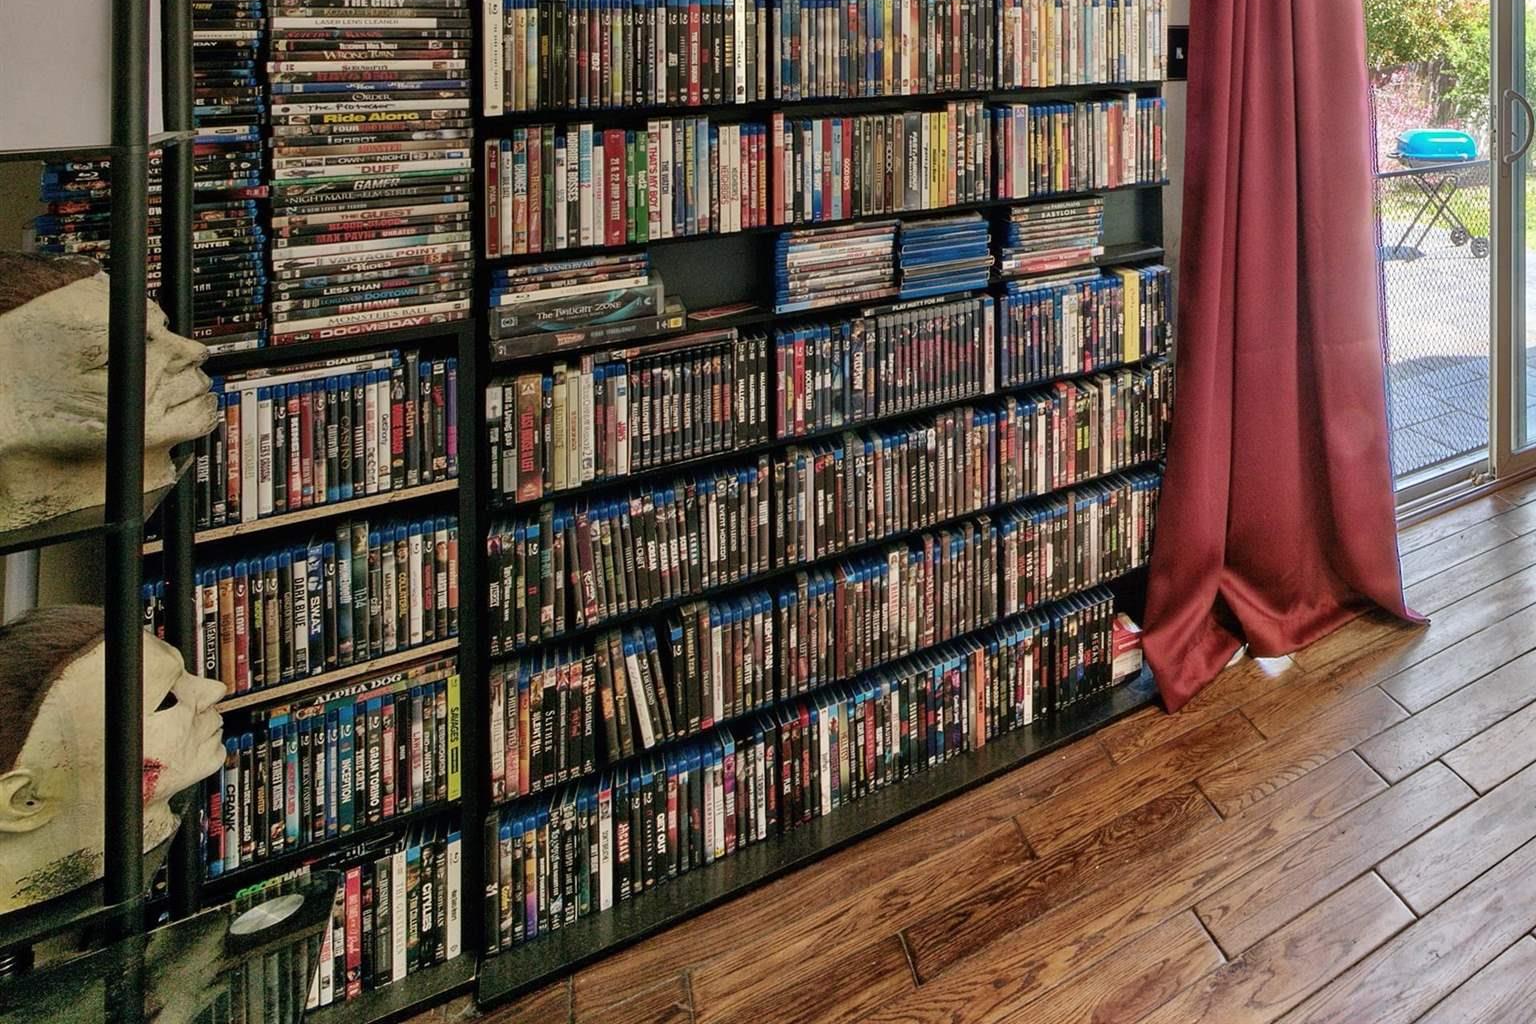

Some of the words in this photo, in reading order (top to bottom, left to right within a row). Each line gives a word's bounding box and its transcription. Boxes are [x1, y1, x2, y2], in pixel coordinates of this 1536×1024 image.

[371, 0, 405, 7] GREY
[323, 113, 366, 123] Ride
[368, 112, 419, 122] Along
[376, 153, 409, 161] NIGHT
[567, 132, 578, 169] HORRIBLE
[649, 147, 657, 174] THAT'S
[361, 164, 400, 173] DUFF
[354, 178, 400, 190] GAMER
[568, 172, 578, 202] BOSSES
[290, 192, 351, 204] NIGHTMARE
[384, 187, 417, 196] STREET
[360, 208, 414, 219] GUEST
[327, 252, 394, 264] VANTAGE
[395, 247, 438, 257] POINT
[324, 286, 349, 295] LESS
[351, 283, 380, 292] THAN
[364, 288, 417, 300] DOGTOWN
[402, 307, 429, 315] BALL
[536, 311, 553, 320] The
[320, 317, 425, 338] DOOMSDAY
[327, 354, 375, 367] DIARIES
[405, 400, 416, 437] u-turn
[341, 416, 350, 469] CASINO
[294, 577, 305, 603] DARK
[236, 606, 245, 634] BLOW
[295, 606, 305, 628] BLUE
[313, 683, 368, 705] ALPHA
[371, 673, 402, 689] DOG
[450, 707, 459, 742] SAVAGES
[369, 746, 379, 769] GRAN
[341, 759, 352, 803] INCEPTION
[369, 772, 379, 806] TORINO
[226, 784, 236, 832] CRANK
[657, 813, 665, 833] GET
[657, 835, 665, 854] OUT
